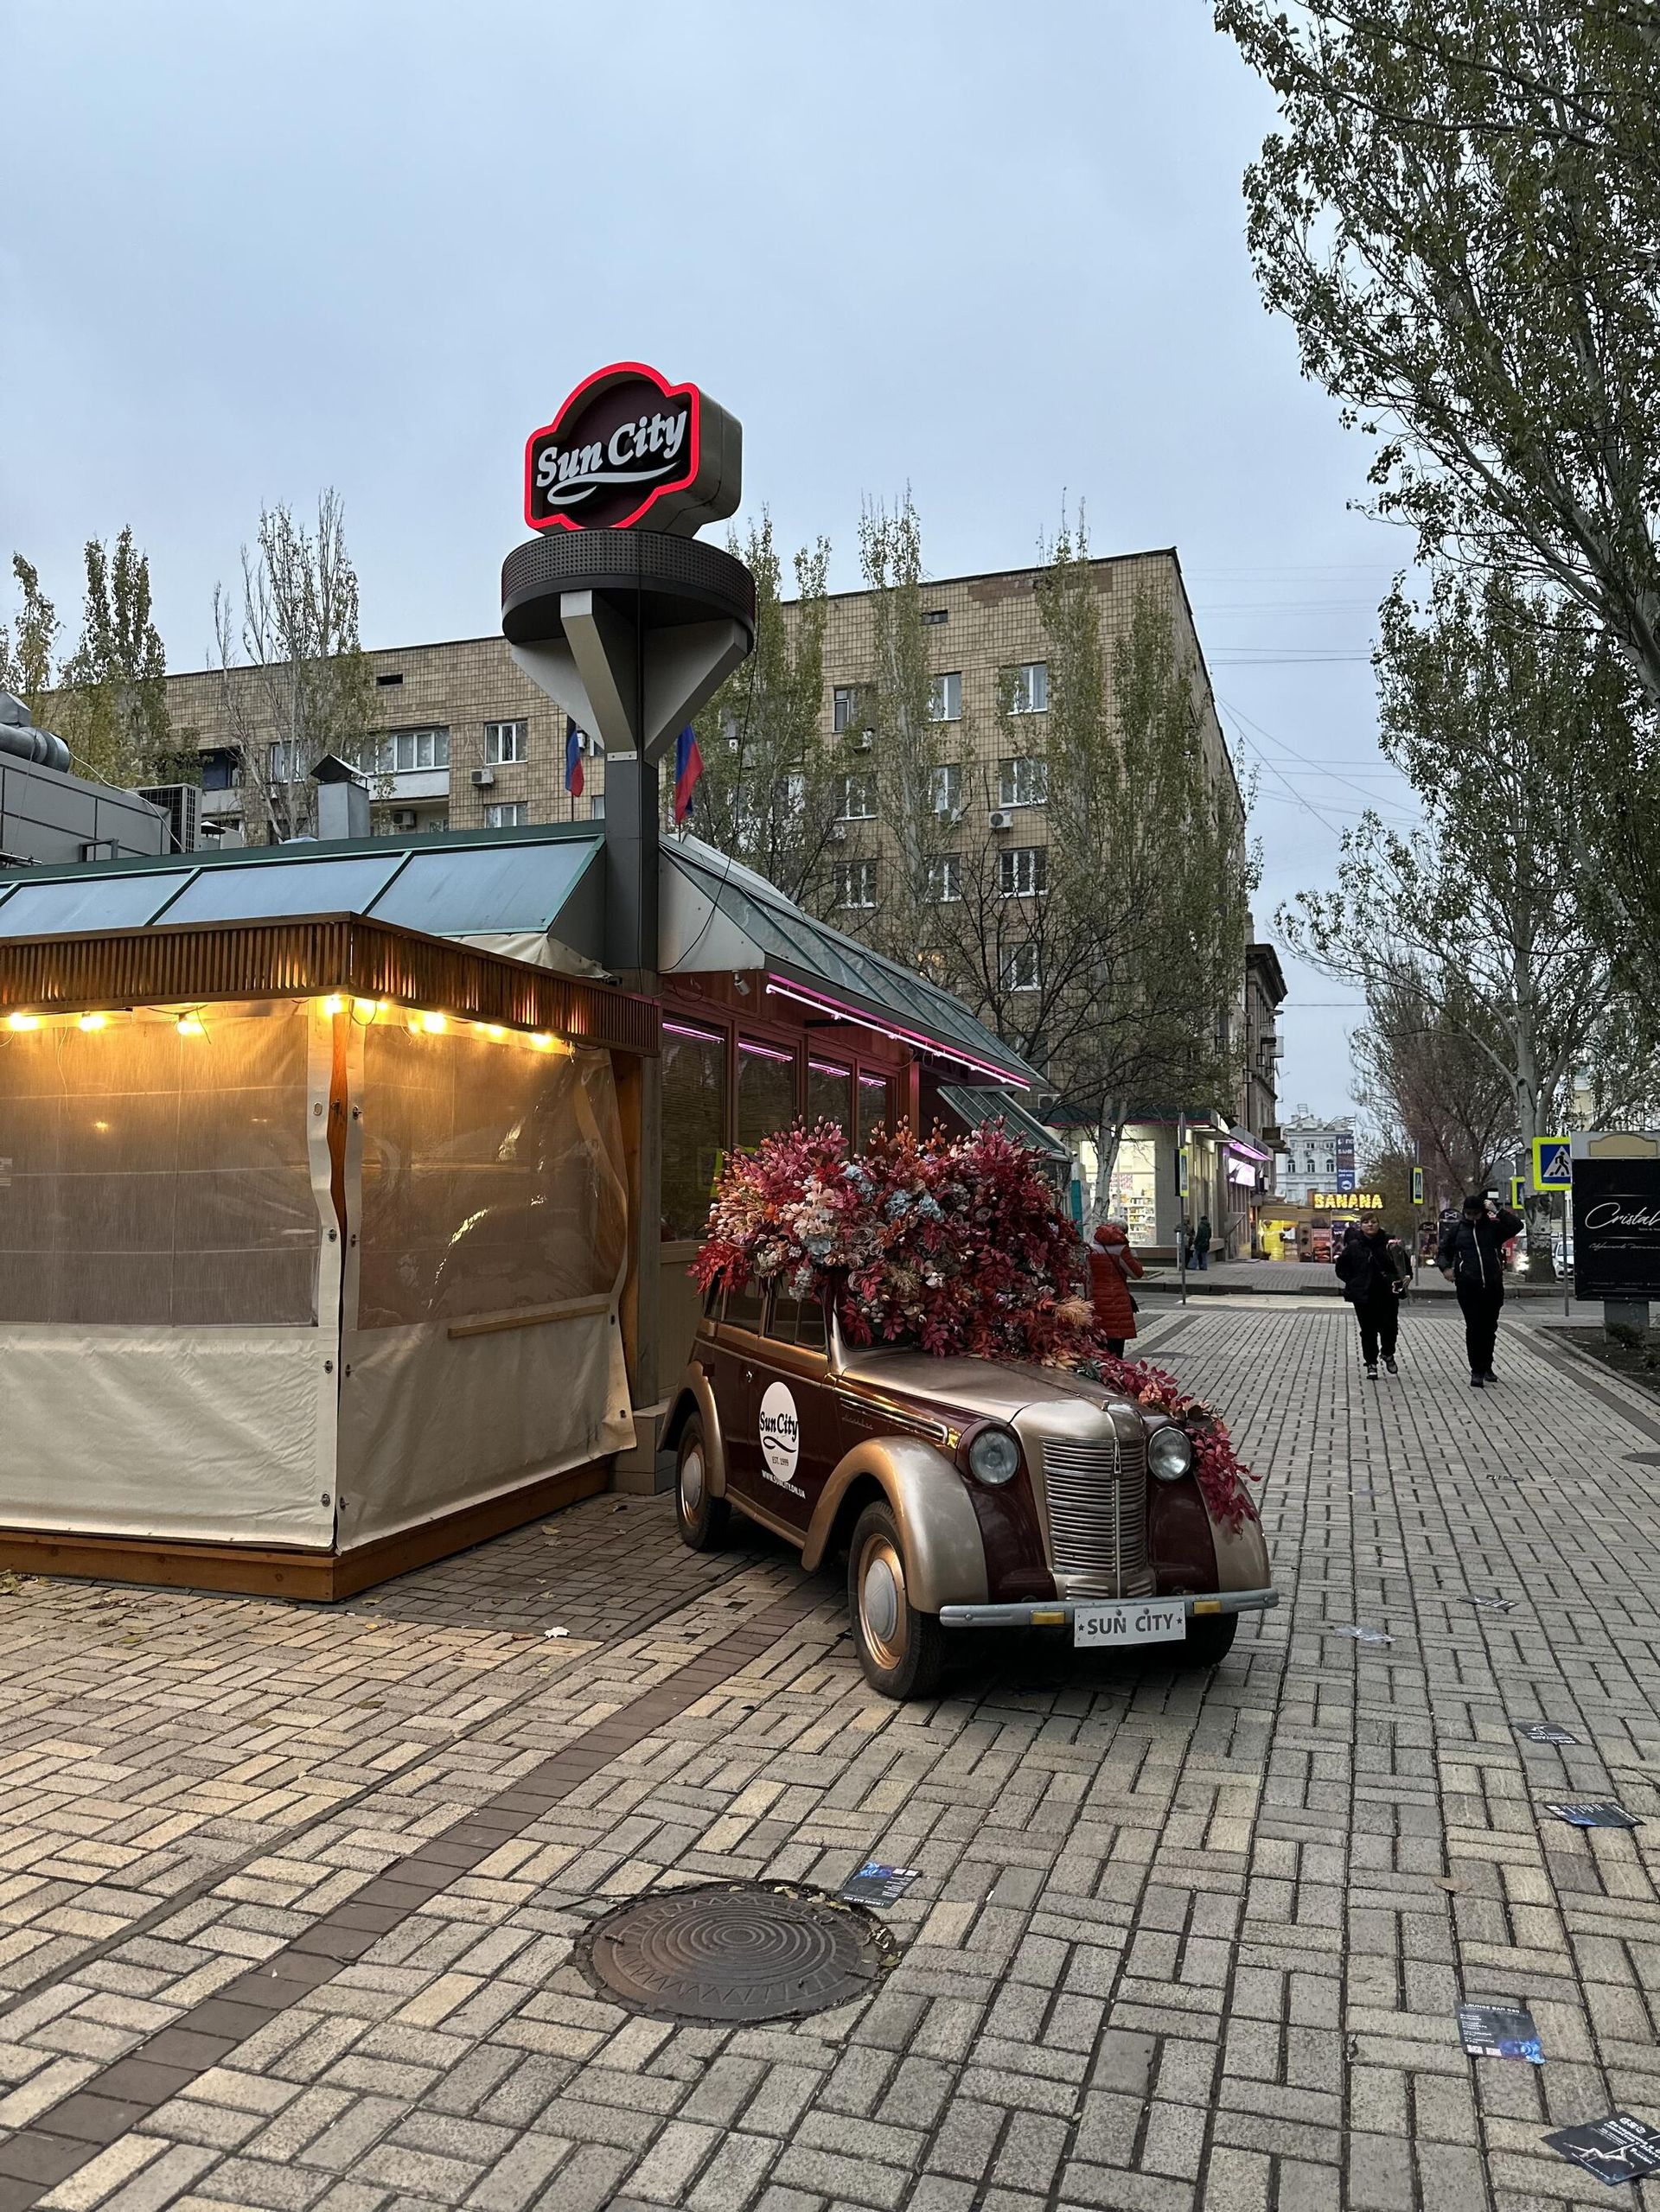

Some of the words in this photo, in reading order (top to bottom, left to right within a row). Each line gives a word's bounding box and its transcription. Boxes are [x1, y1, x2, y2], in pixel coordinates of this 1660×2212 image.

[536, 442, 603, 488] Sun
[608, 410, 687, 465] City
[1313, 1194, 1383, 1208] BANANA
[760, 1411, 776, 1432] Sun
[777, 1412, 799, 1443] City
[1087, 1617, 1127, 1635] SUN
[1135, 1613, 1174, 1633] CITY
